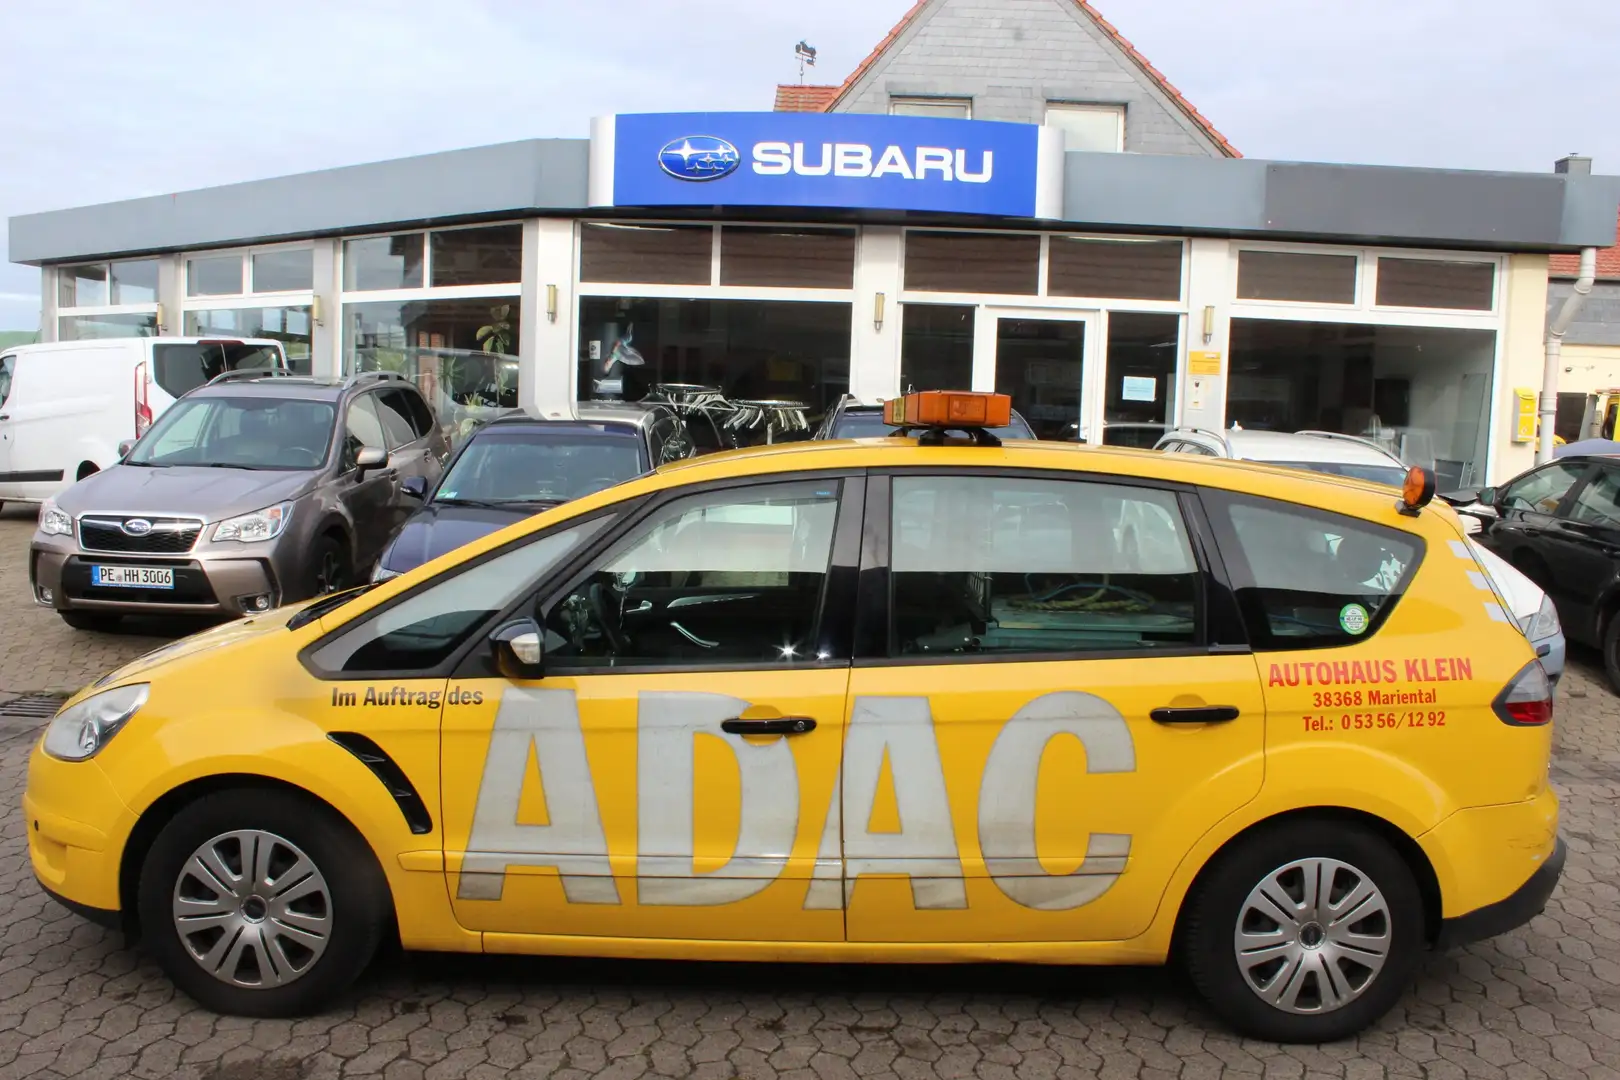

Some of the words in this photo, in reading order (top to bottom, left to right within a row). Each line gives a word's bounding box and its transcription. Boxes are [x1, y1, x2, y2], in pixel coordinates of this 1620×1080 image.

[752, 142, 993, 184] SUBARU
[101, 568, 115, 582] PE
[124, 569, 139, 583] HH
[142, 570, 171, 584] 3006
[1269, 660, 1397, 687] AUTOHAUS
[1404, 658, 1473, 683] KLEIN
[332, 687, 356, 706] Im
[363, 686, 442, 709] Auftrag
[448, 686, 484, 706] des
[1313, 691, 1363, 707] 38368
[1368, 688, 1437, 706] Mariental
[1303, 715, 1333, 731] Tel.:
[456, 688, 1137, 911] ADAC
